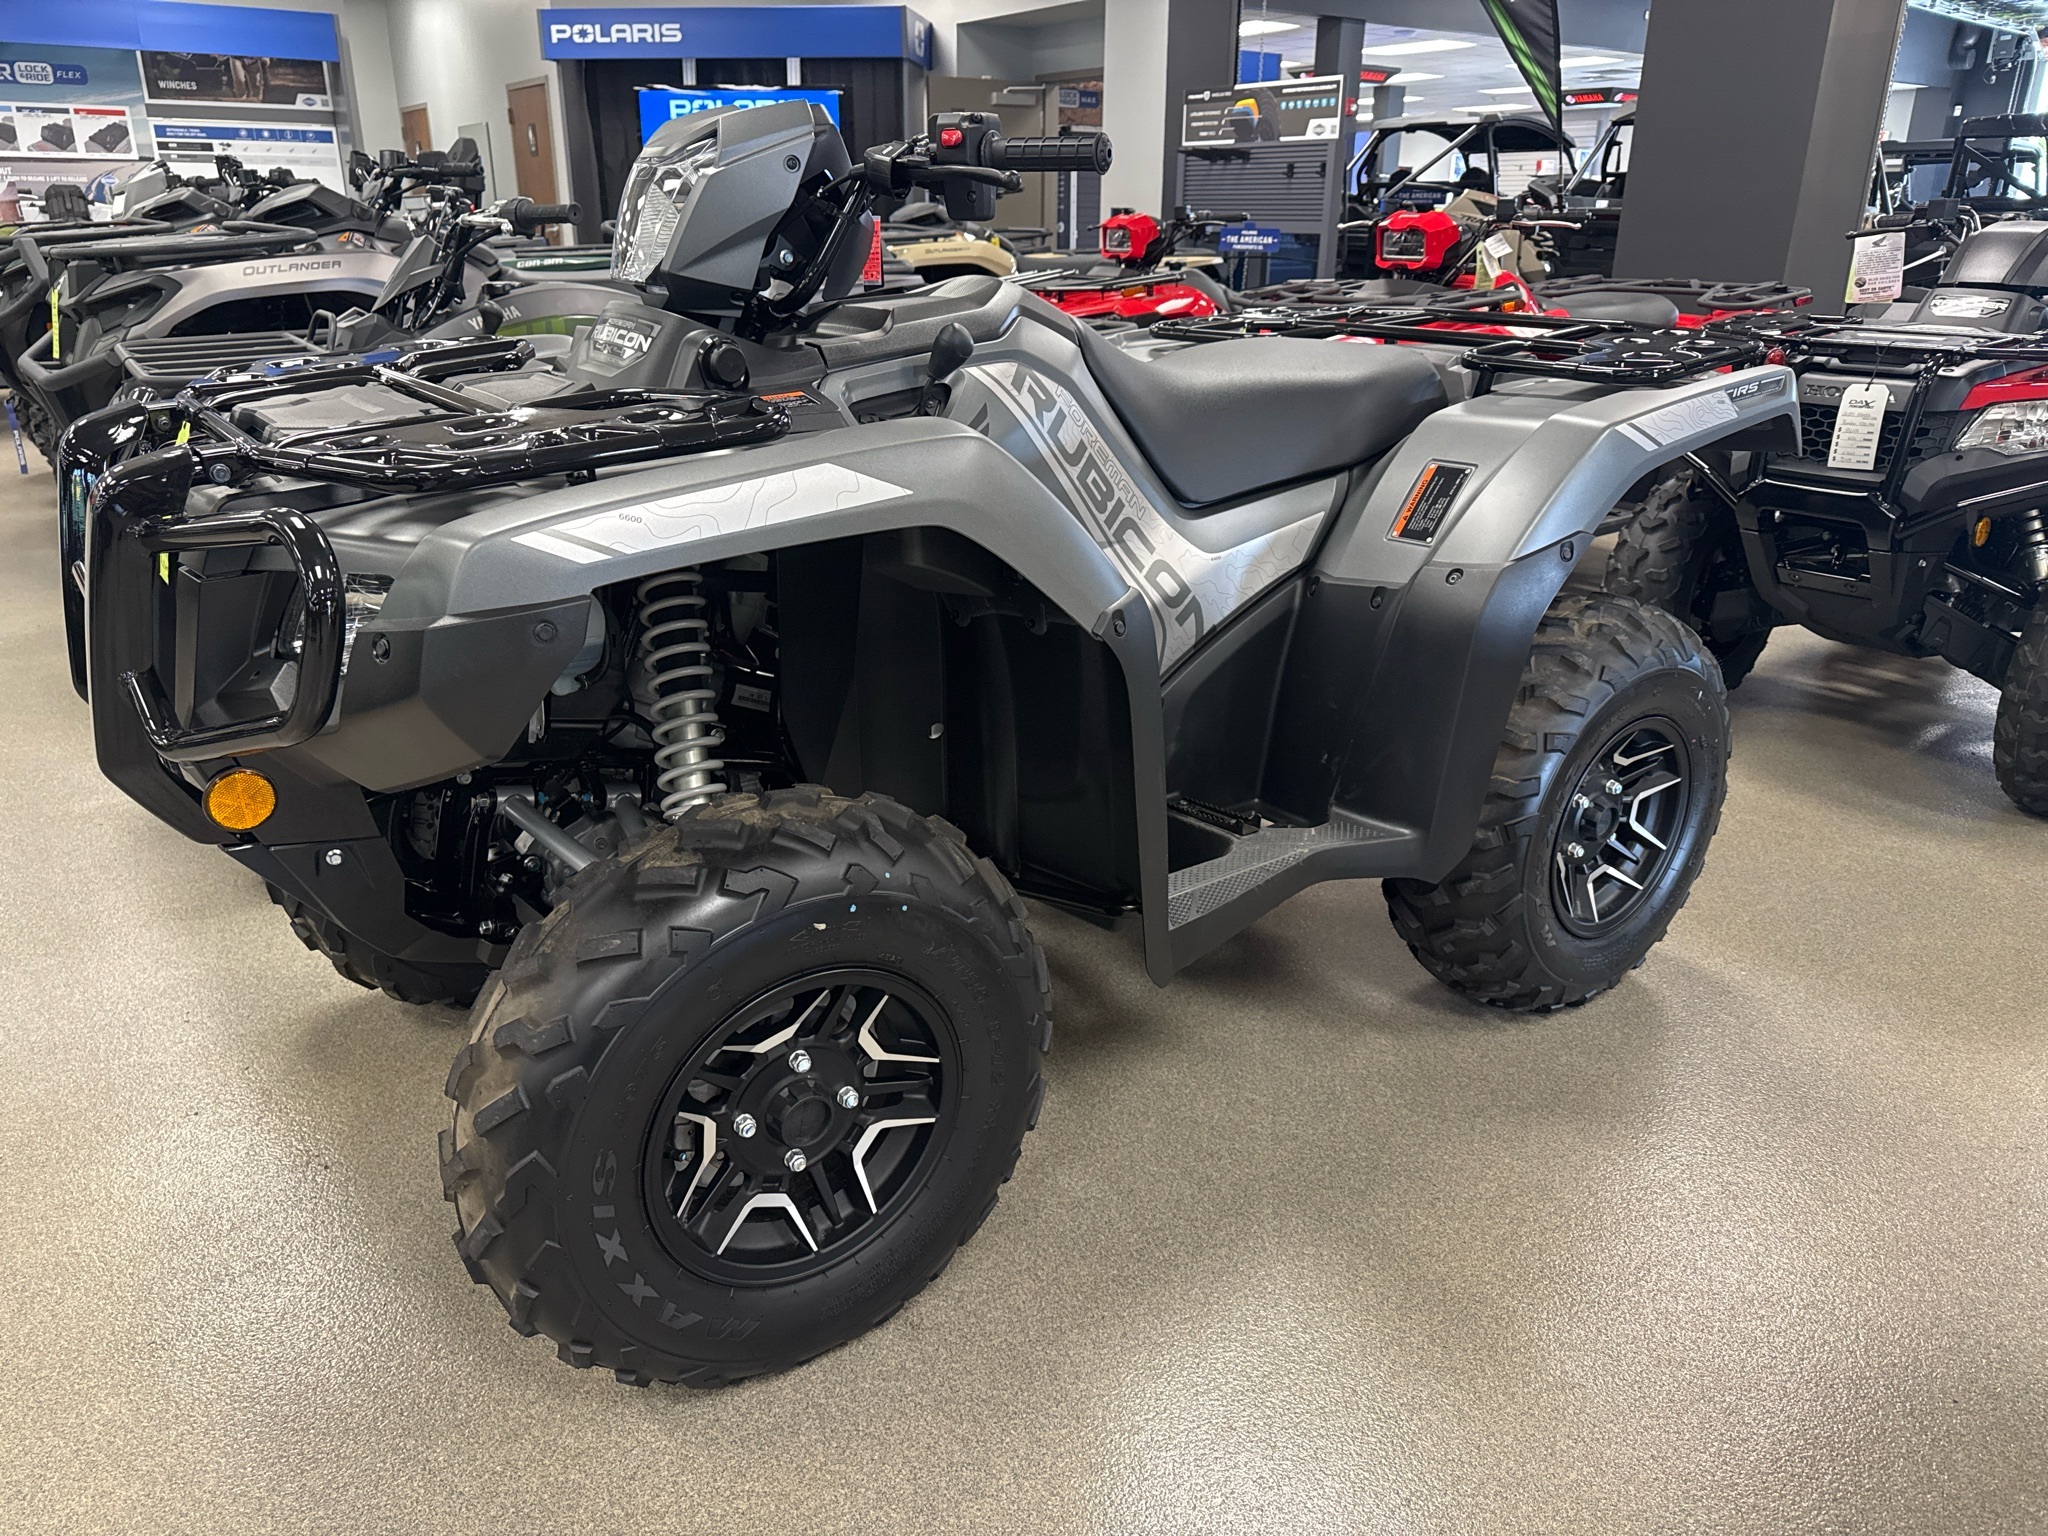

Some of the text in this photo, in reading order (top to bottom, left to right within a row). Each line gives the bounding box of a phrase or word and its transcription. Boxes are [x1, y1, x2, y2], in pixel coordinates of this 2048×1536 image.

[550, 23, 683, 44] POLARIS
[17, 64, 50, 73] LOCK
[56, 70, 82, 79] FLEX
[157, 79, 198, 91] WINCHES
[1226, 235, 1273, 244] THE AMERICAN
[243, 260, 342, 276] OUTLANDER
[591, 324, 653, 353] RUBICON
[1732, 381, 1760, 398] IRS
[1848, 399, 1876, 408] DAX
[1054, 384, 1147, 521] FOREMAN
[1407, 479, 1429, 513] WARNING
[618, 512, 643, 524] 6600
[591, 1149, 762, 1341] MAXXIS
